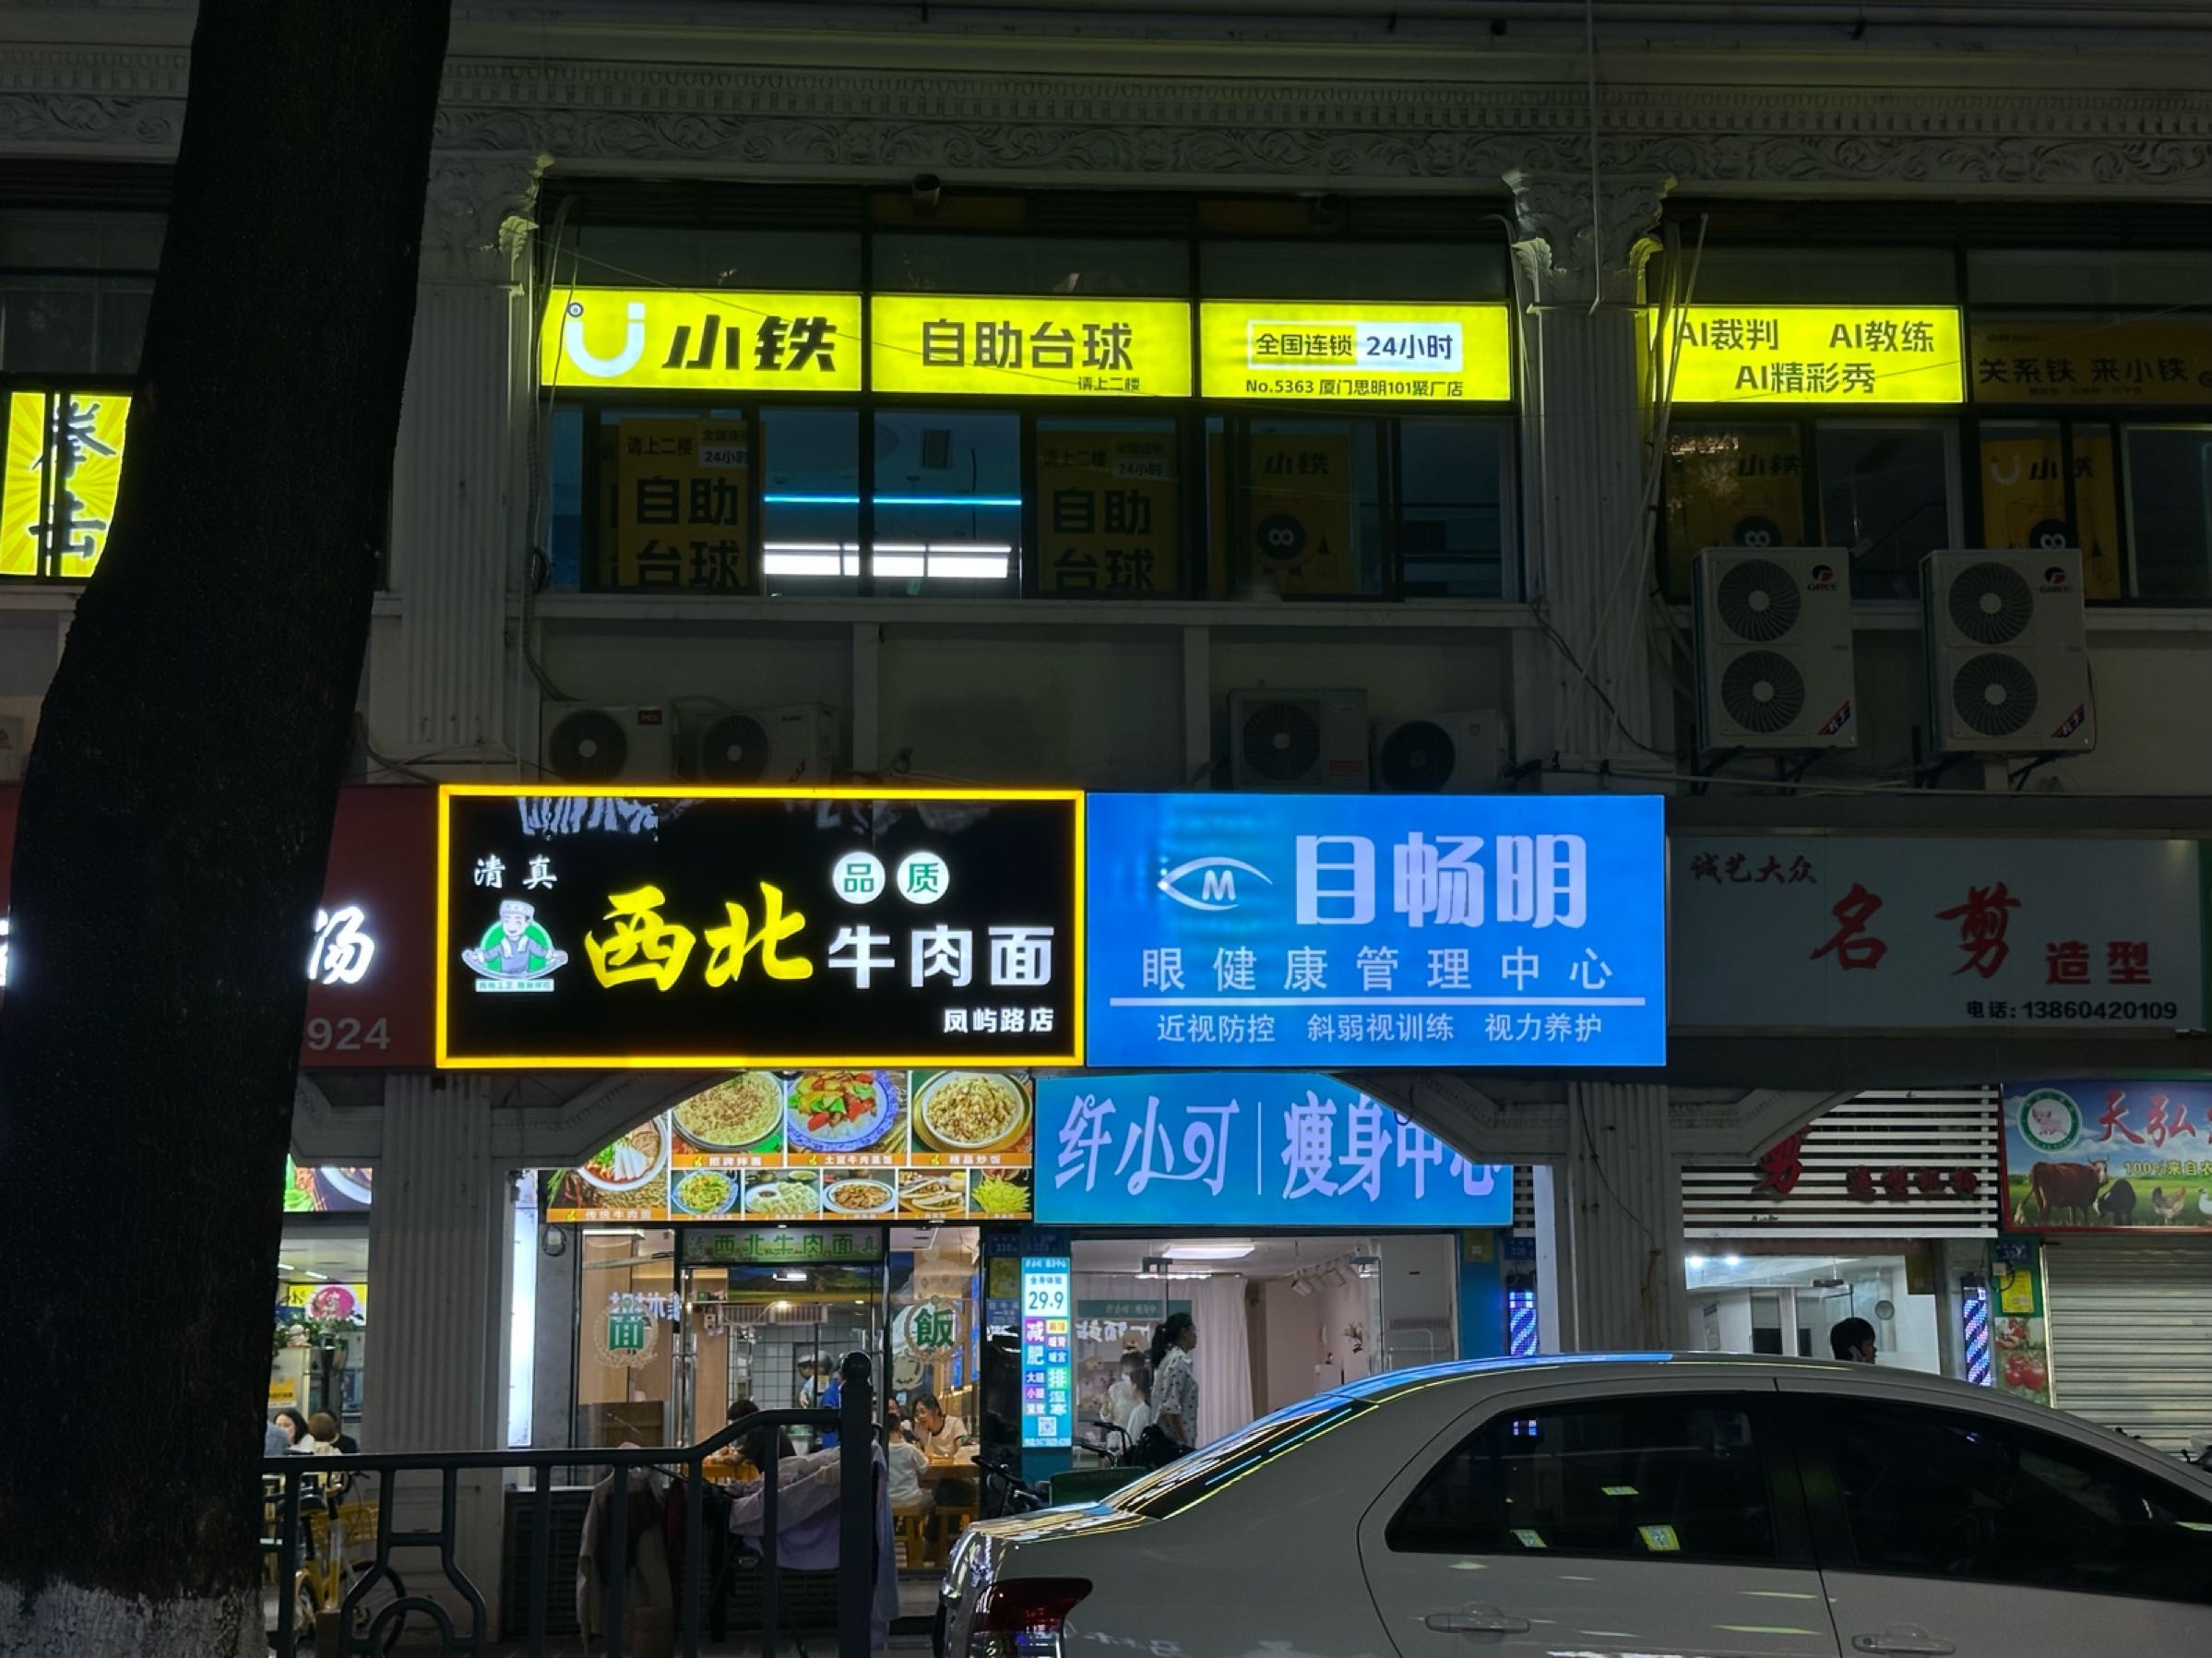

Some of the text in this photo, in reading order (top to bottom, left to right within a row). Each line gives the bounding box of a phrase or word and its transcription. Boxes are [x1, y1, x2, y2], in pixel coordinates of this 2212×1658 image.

[660, 315, 838, 372] 小铁
[922, 318, 1134, 371] 自助台球
[1255, 333, 1454, 360] 全国连锁 24小时
[1677, 318, 1935, 353] AI裁判 AI教练
[1077, 376, 1141, 392] 请上二楼
[1735, 361, 1876, 396] AI精彩秀
[1979, 357, 2076, 384] 关系铁
[2089, 357, 2190, 384] 来小铁
[1245, 380, 1465, 398] No.5363 厦门思明101聚厂店
[627, 435, 694, 457] 请上二楼
[1262, 450, 1329, 476] 小铁
[636, 474, 739, 526] 自助
[1052, 486, 1152, 536] 自助
[636, 539, 741, 591] 台球
[1052, 547, 1157, 591] 台球
[473, 853, 558, 889] 清真
[843, 862, 940, 894] 品质
[1293, 830, 1588, 929] 目畅明
[1689, 852, 1817, 886] 诚艺大众
[584, 880, 1054, 992] 西北 牛肉面
[1808, 881, 2153, 985] 名剪 造型
[1140, 945, 1614, 993] 眼健康管理中心
[305, 1017, 391, 1052] 924
[943, 1007, 1055, 1034] 凤屿路店
[1156, 1013, 1603, 1044] 近视防控 斜弱视训练 视力养护
[2098, 1089, 2212, 1150] 天弘
[1053, 1090, 1502, 1203] 纤小可 瘦身中心
[715, 1234, 854, 1257] 西北牛肉面
[1029, 1291, 1064, 1310] 29.9
